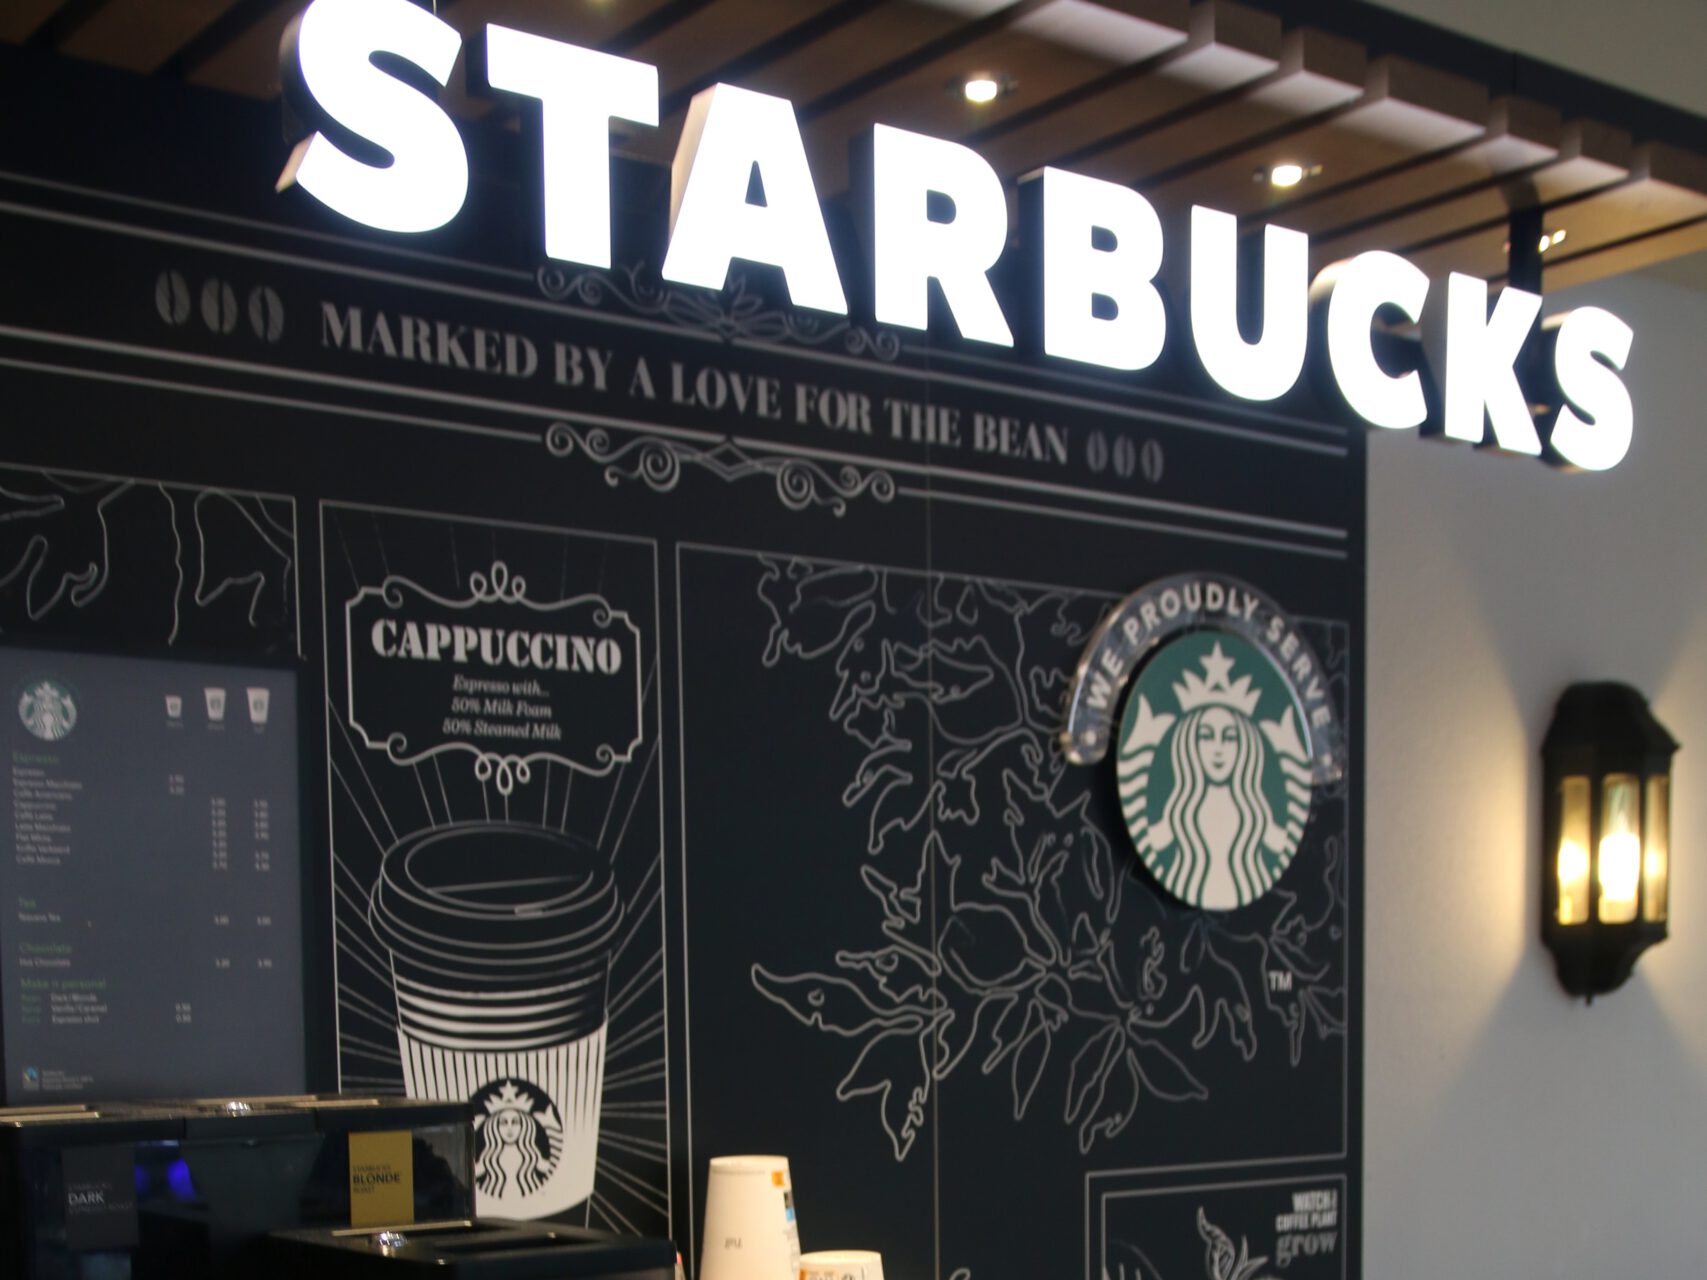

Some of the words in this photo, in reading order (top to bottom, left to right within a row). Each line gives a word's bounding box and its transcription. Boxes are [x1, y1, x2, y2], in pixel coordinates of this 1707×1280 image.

[290, 0, 1635, 472] STARBUCKS
[320, 301, 538, 380] MARKED
[554, 340, 616, 392] BY
[629, 356, 657, 399] A
[671, 362, 781, 418] LOVE
[795, 383, 872, 434] FOR
[884, 398, 961, 447] THE
[973, 411, 1068, 465] BEAN
[371, 618, 622, 675] CAPPUCCINO
[1086, 648, 1124, 710] WE
[1122, 582, 1258, 645] PROUDLY
[1265, 615, 1331, 729] SERVE
[452, 673, 510, 695] Espresso
[451, 696, 480, 714] 50%
[484, 698, 513, 716] Milk
[516, 700, 552, 718] Foam
[442, 717, 472, 735] 50%
[473, 718, 530, 738] Steamed
[531, 721, 562, 741] Milk
[1268, 970, 1292, 992] TM
[353, 1171, 401, 1184] BLONDE
[68, 1189, 105, 1206] DARK
[1275, 1231, 1339, 1269] grow
